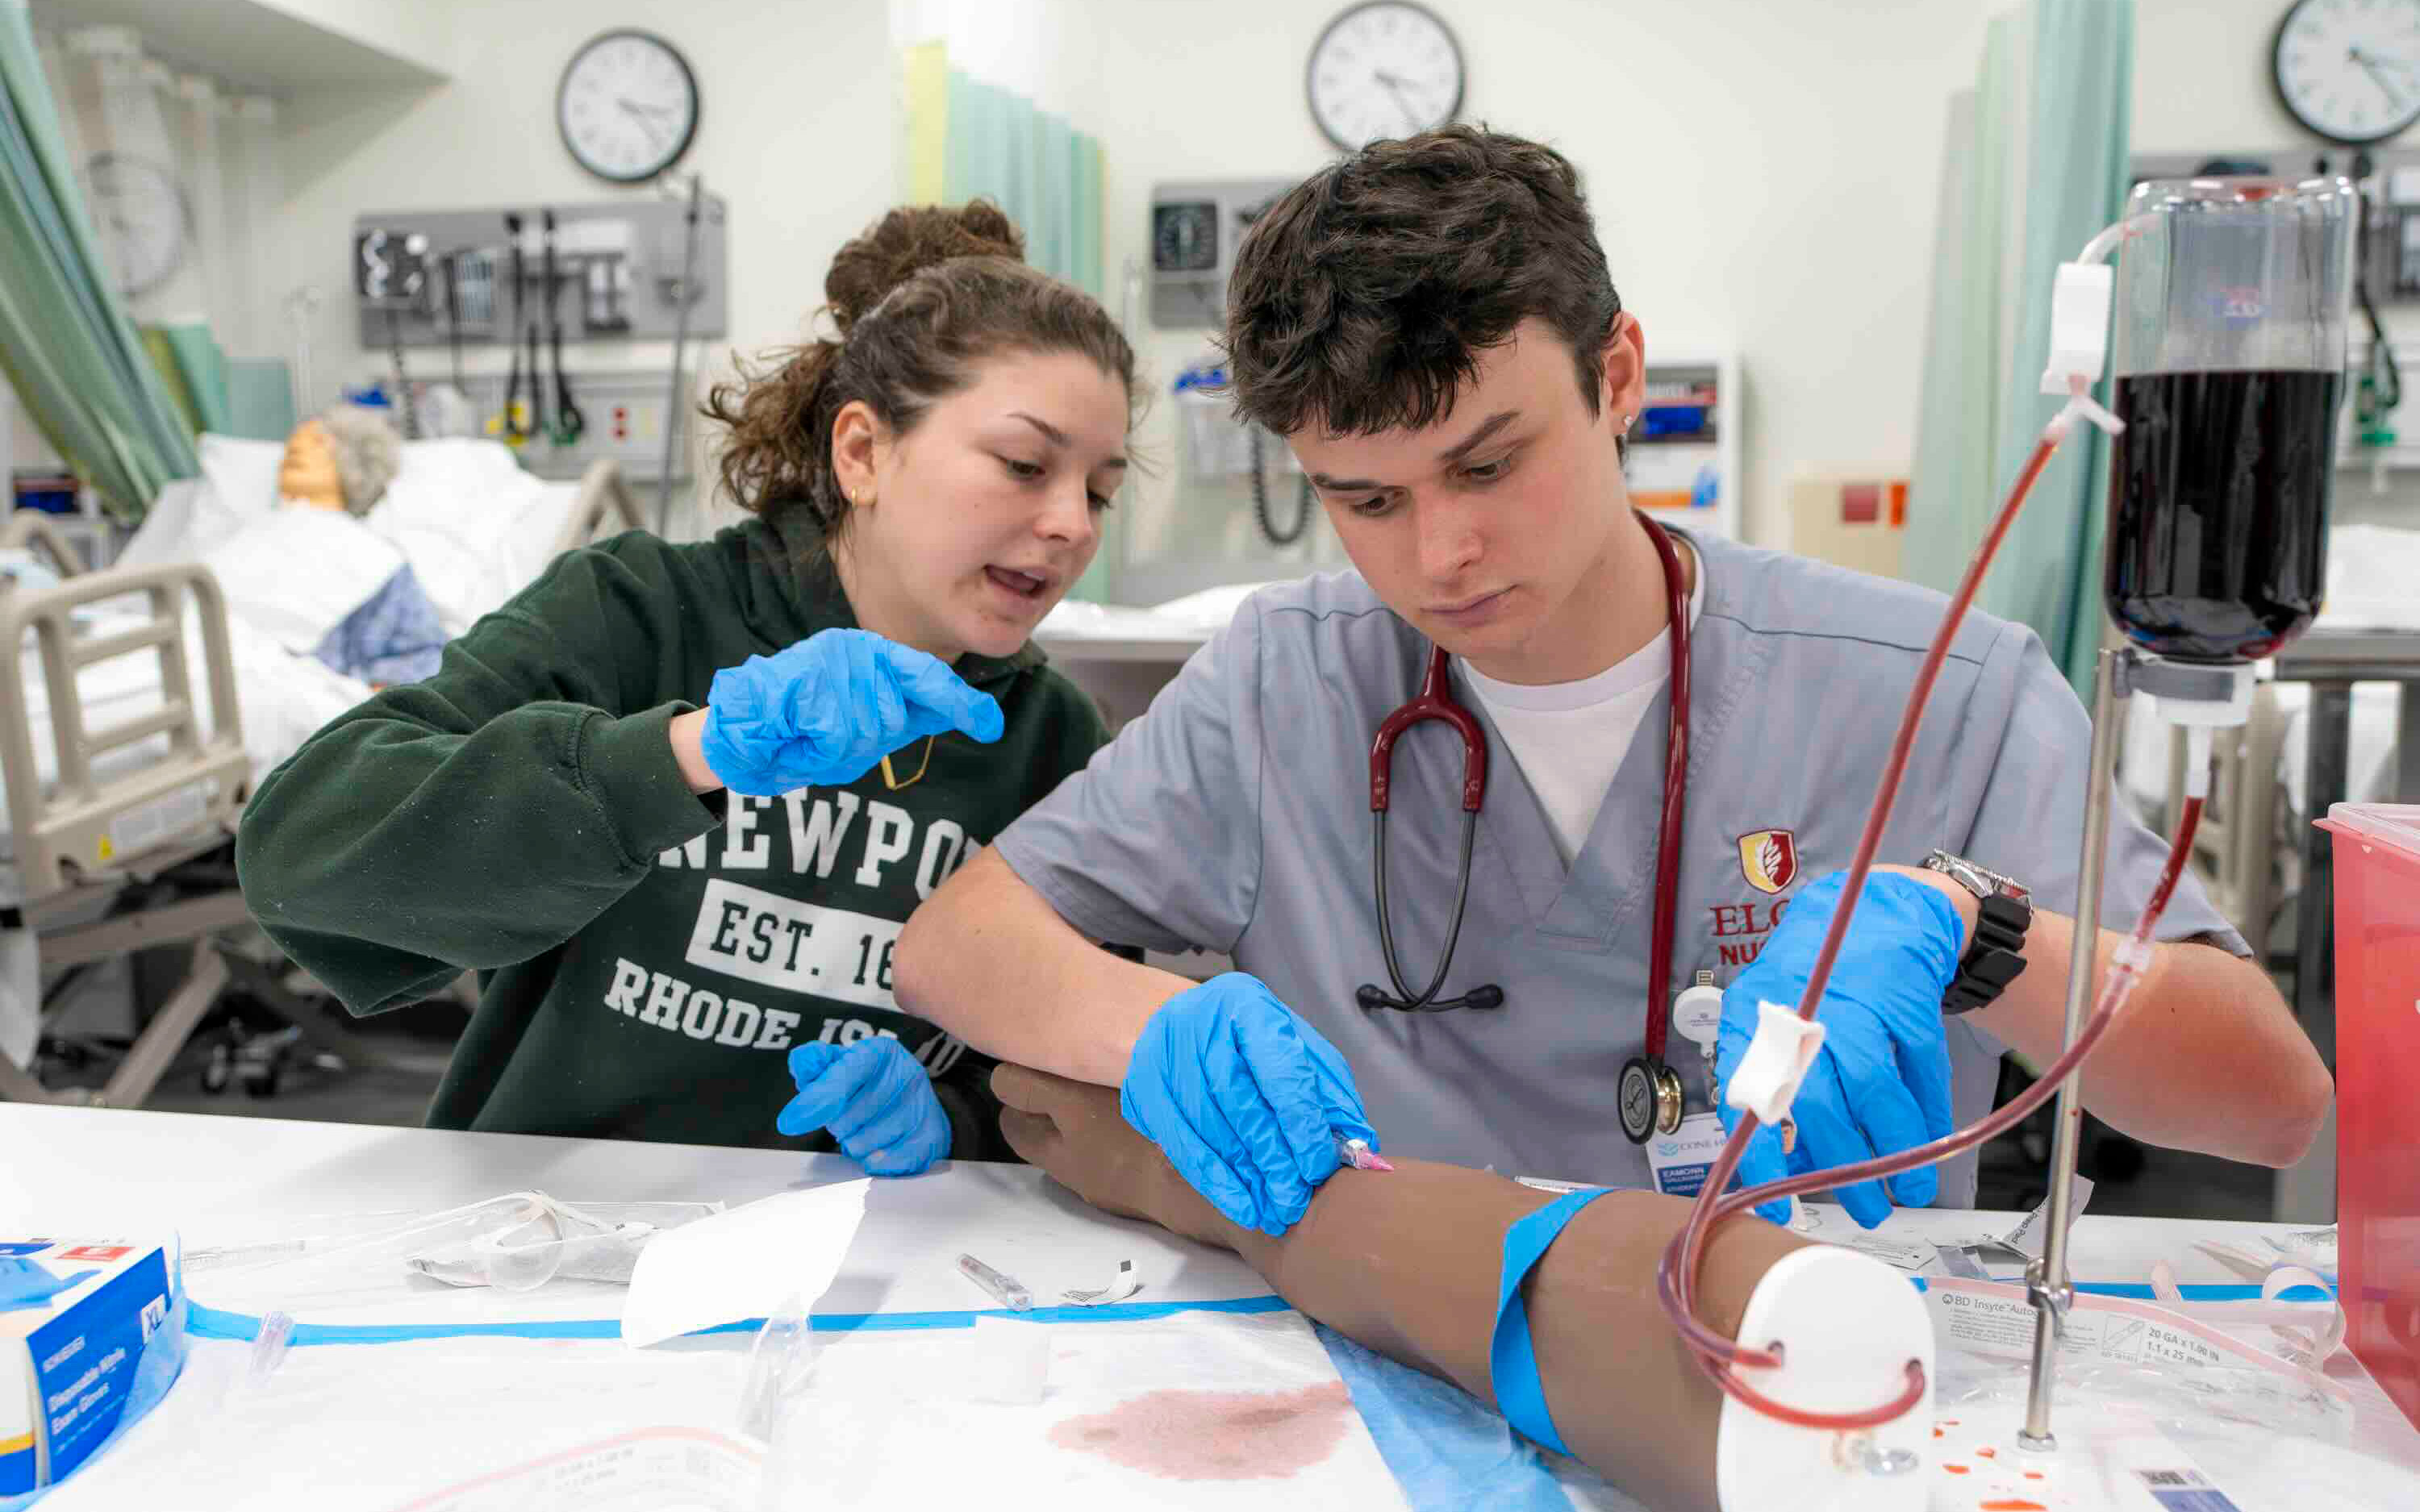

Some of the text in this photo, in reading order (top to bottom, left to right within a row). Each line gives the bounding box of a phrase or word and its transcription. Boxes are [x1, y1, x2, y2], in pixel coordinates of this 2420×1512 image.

[658, 789, 963, 901] EWPO
[710, 900, 820, 976] EST.
[1718, 939, 1767, 965] NU
[604, 957, 801, 1050] RHODE
[1955, 1297, 1970, 1306] BD
[2148, 1327, 2161, 1339] 20
[2163, 1332, 2178, 1343] GA
[2172, 1349, 2184, 1360] 25
